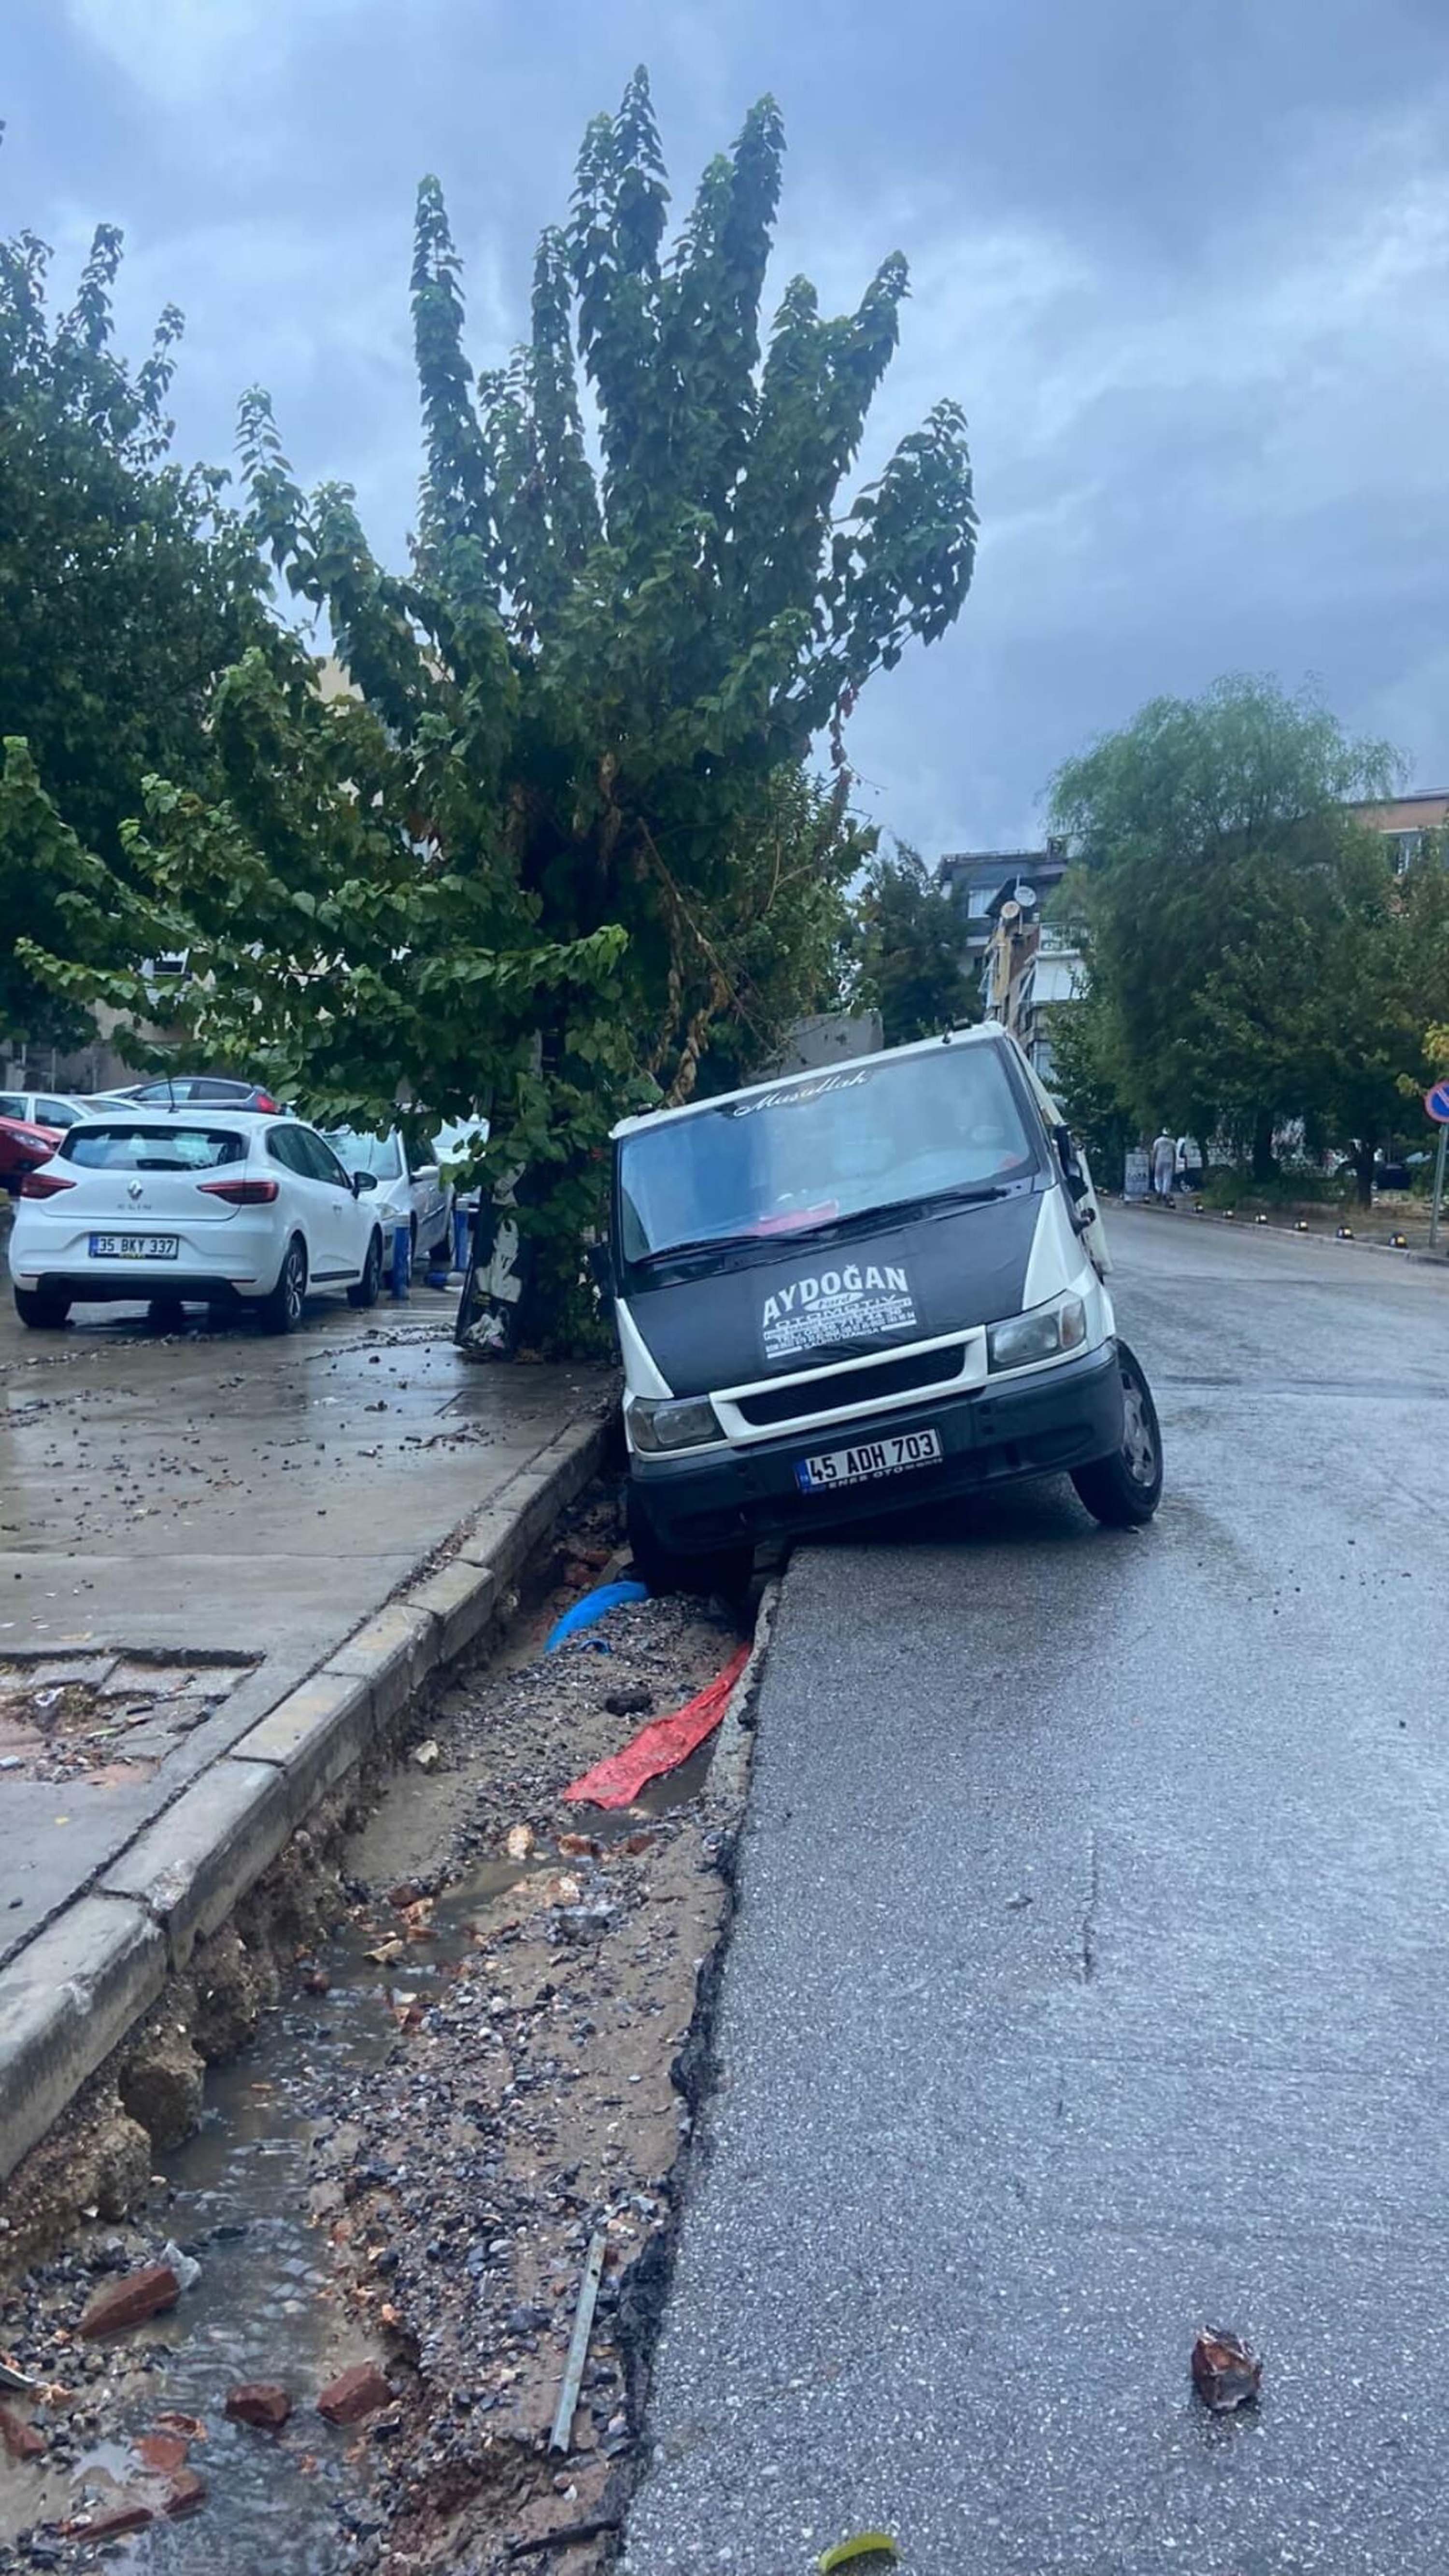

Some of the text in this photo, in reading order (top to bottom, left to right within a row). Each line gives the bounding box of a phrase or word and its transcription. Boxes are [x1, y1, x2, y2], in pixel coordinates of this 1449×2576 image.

[100, 1238, 174, 1253] 35 BKY 337
[763, 1264, 909, 1328] AYDOĞAN
[810, 1457, 837, 1481] 45
[847, 1444, 886, 1474] ADH
[892, 1434, 935, 1463] 703
